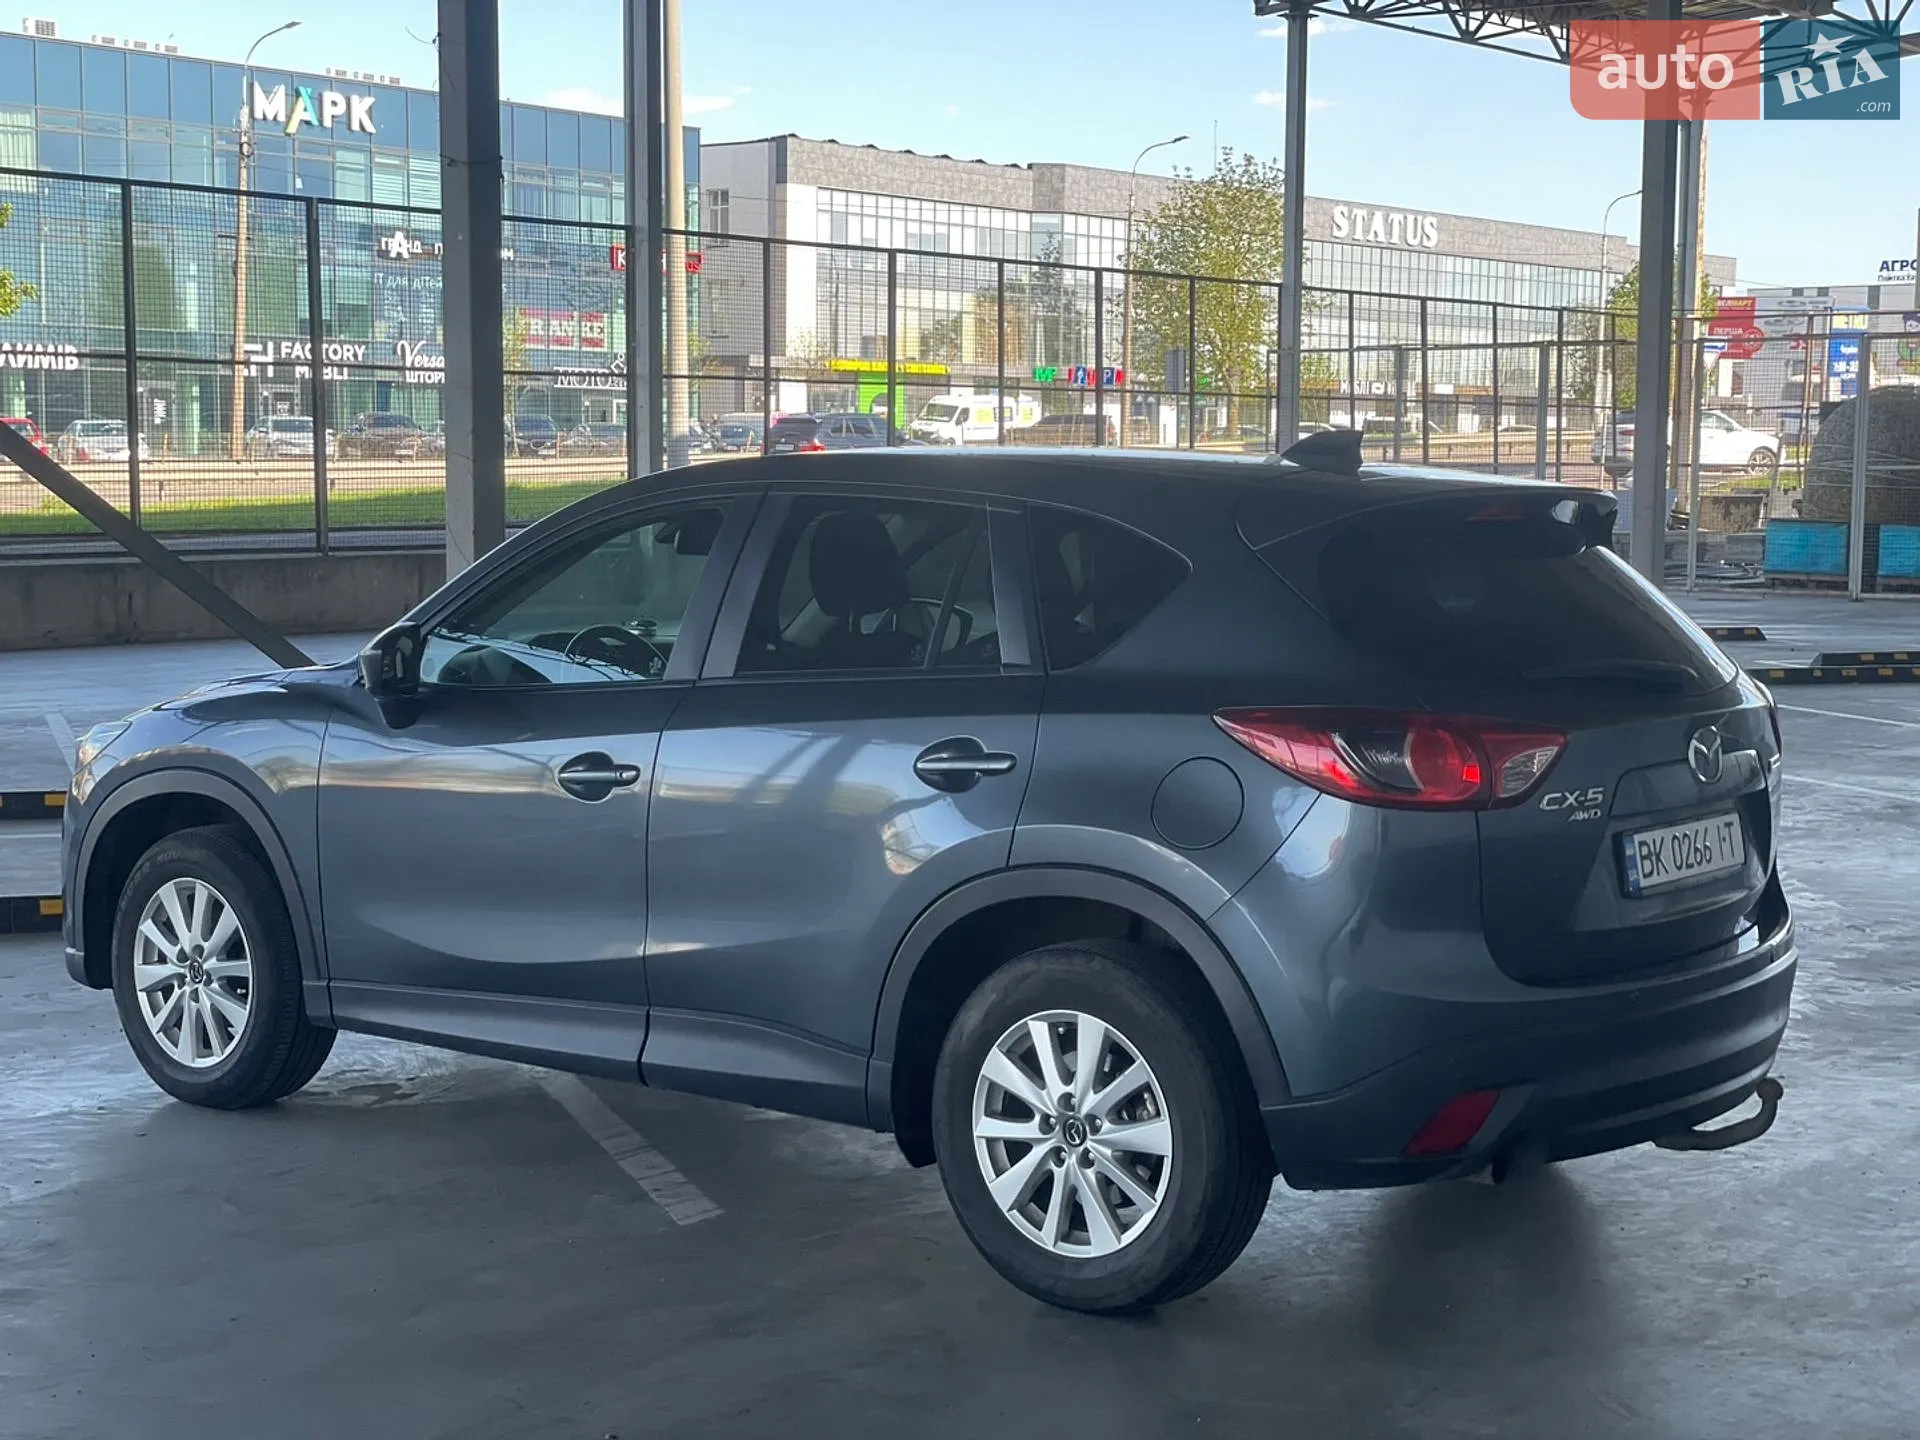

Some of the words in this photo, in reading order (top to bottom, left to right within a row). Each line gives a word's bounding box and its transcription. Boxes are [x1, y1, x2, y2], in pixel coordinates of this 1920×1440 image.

[253, 80, 377, 136] МАРК
[1332, 204, 1439, 249] STATUS
[1340, 379, 1371, 395] МБЛІ
[1539, 787, 1604, 811] CX-5
[1567, 808, 1601, 822] AWD
[1638, 836, 1670, 879] BK
[1671, 826, 1713, 872] 0266
[1716, 821, 1736, 861] IT
